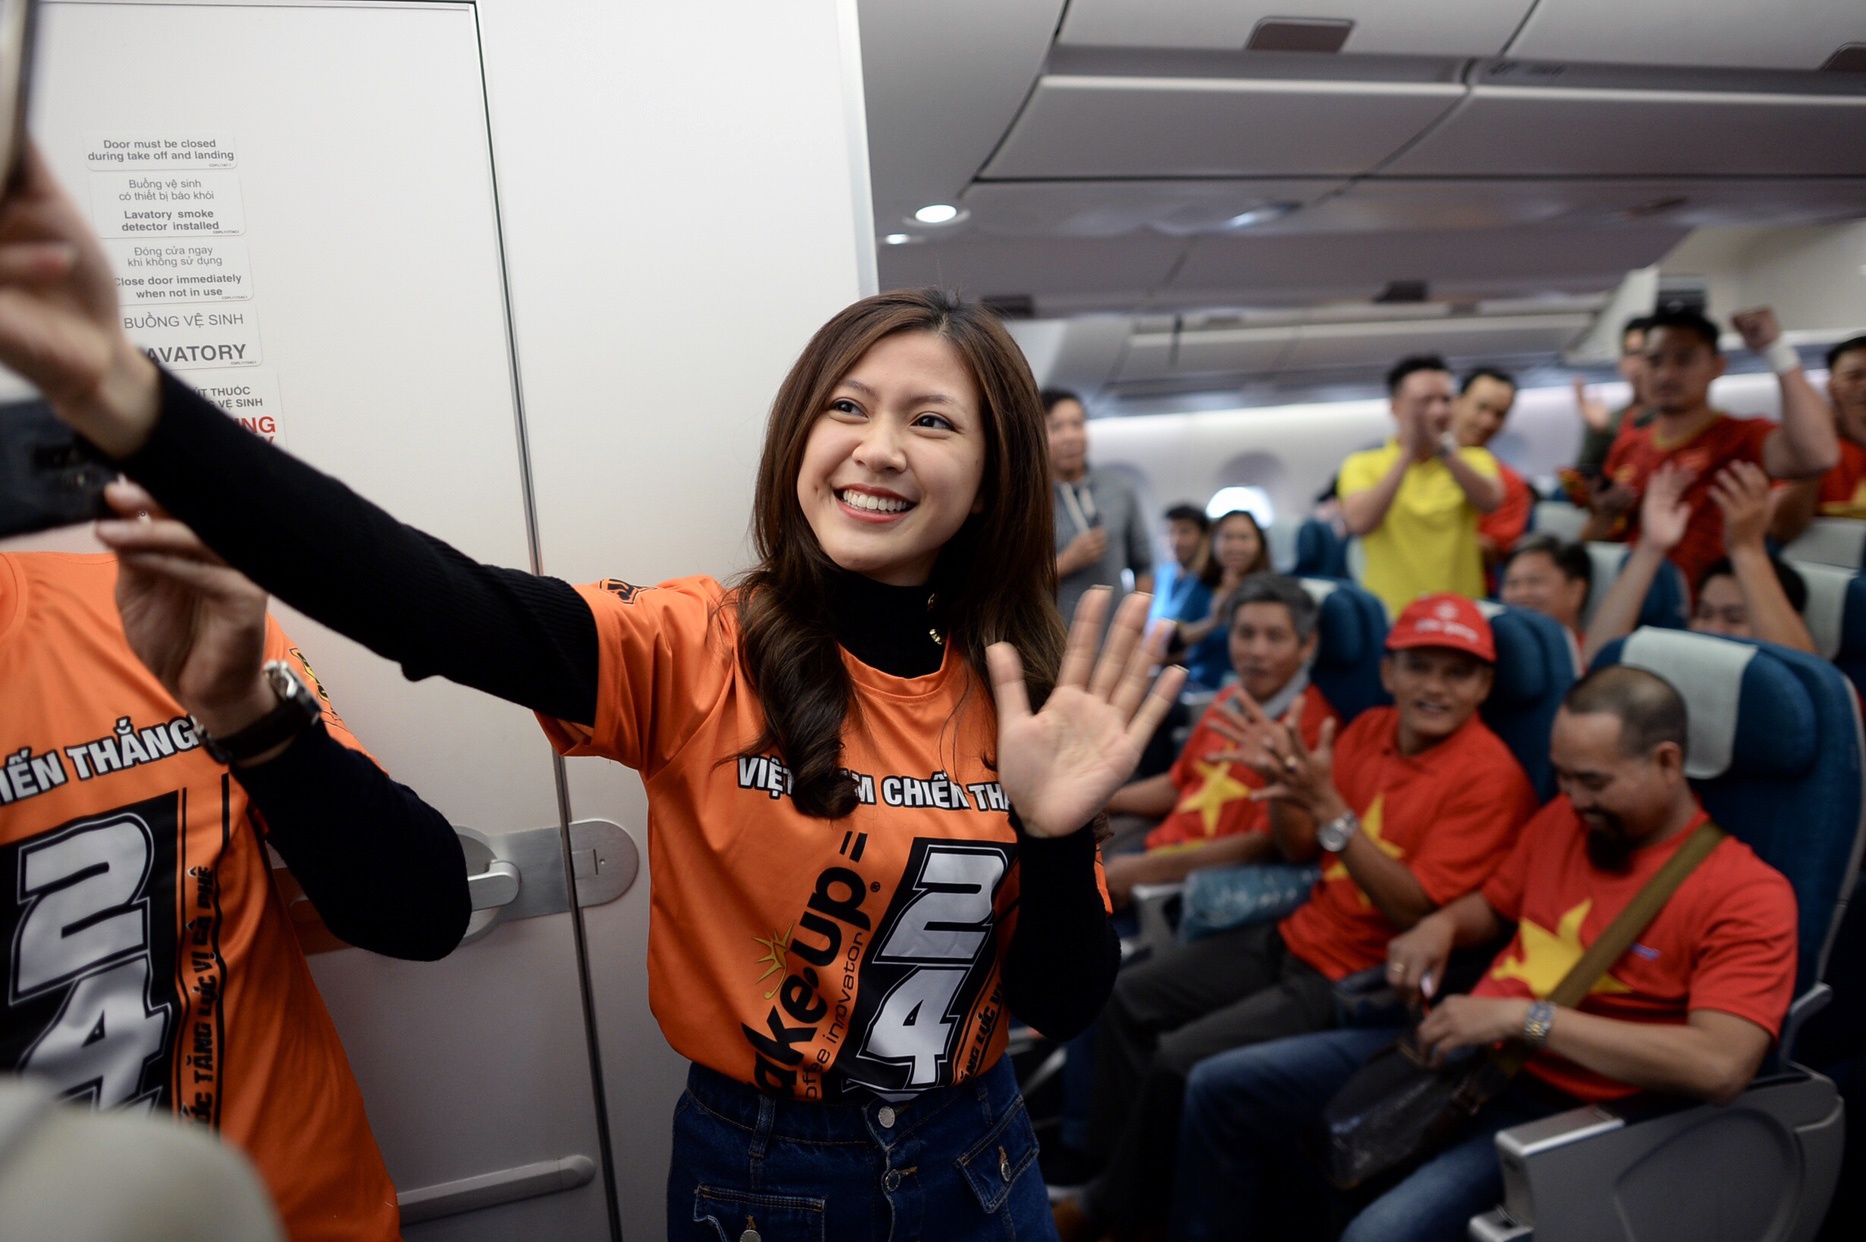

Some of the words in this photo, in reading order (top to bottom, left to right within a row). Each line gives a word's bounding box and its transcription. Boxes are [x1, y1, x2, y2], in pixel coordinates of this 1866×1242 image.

[103, 139, 131, 149] Door
[134, 140, 162, 149] must
[164, 139, 178, 148] be
[181, 139, 216, 148] closed
[88, 151, 124, 162] during
[127, 151, 150, 161] take
[153, 151, 168, 160] off
[171, 151, 192, 160] and
[194, 150, 235, 161] landing
[128, 177, 162, 190] Buồng
[165, 179, 178, 189] vệ
[180, 178, 202, 188] sinh
[119, 191, 132, 201] có
[159, 191, 169, 202] bị
[171, 191, 191, 200] báo
[124, 210, 172, 221] Lavatory
[177, 209, 214, 219] smoke
[121, 222, 168, 232] detector
[172, 221, 219, 231] installed
[134, 246, 163, 258] Đóng
[188, 246, 213, 257] ngay
[127, 258, 143, 267] khi
[146, 256, 178, 268] không
[197, 256, 223, 267] dụng
[147, 276, 173, 286] door
[176, 273, 242, 285] immediately
[136, 289, 166, 299] when
[169, 288, 186, 298] not
[190, 287, 200, 297] in
[203, 287, 223, 297] use
[123, 311, 180, 329] BUỒNG
[183, 312, 203, 329] VỆ
[208, 313, 244, 326] SINH
[147, 343, 247, 363] AVATORY
[236, 398, 263, 408] SINH
[0, 748, 67, 804] IẾN
[64, 717, 201, 781] THẮNG
